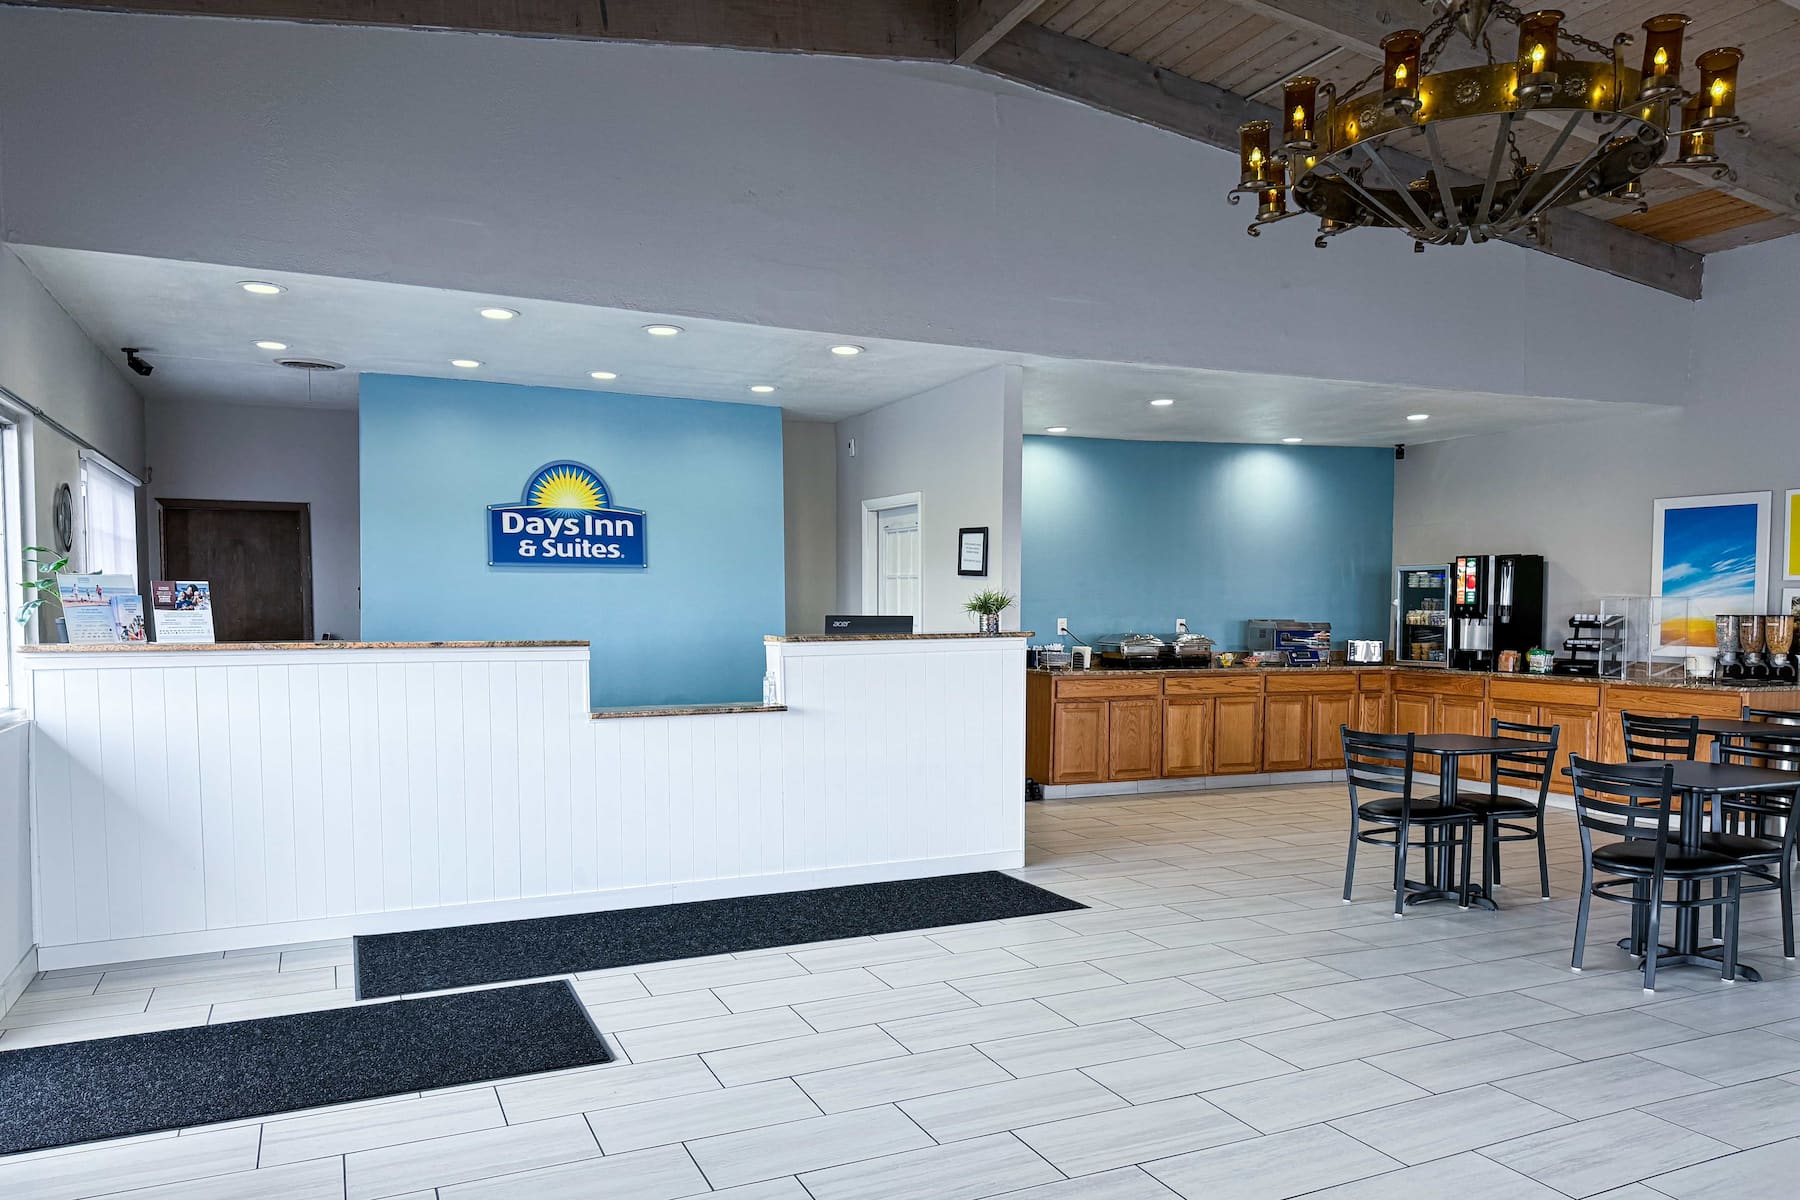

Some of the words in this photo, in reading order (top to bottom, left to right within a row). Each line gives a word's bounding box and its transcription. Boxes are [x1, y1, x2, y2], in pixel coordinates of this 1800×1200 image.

[502, 511, 580, 538] Days
[585, 514, 634, 537] Inn
[518, 539, 538, 557] &
[832, 620, 851, 628] acer
